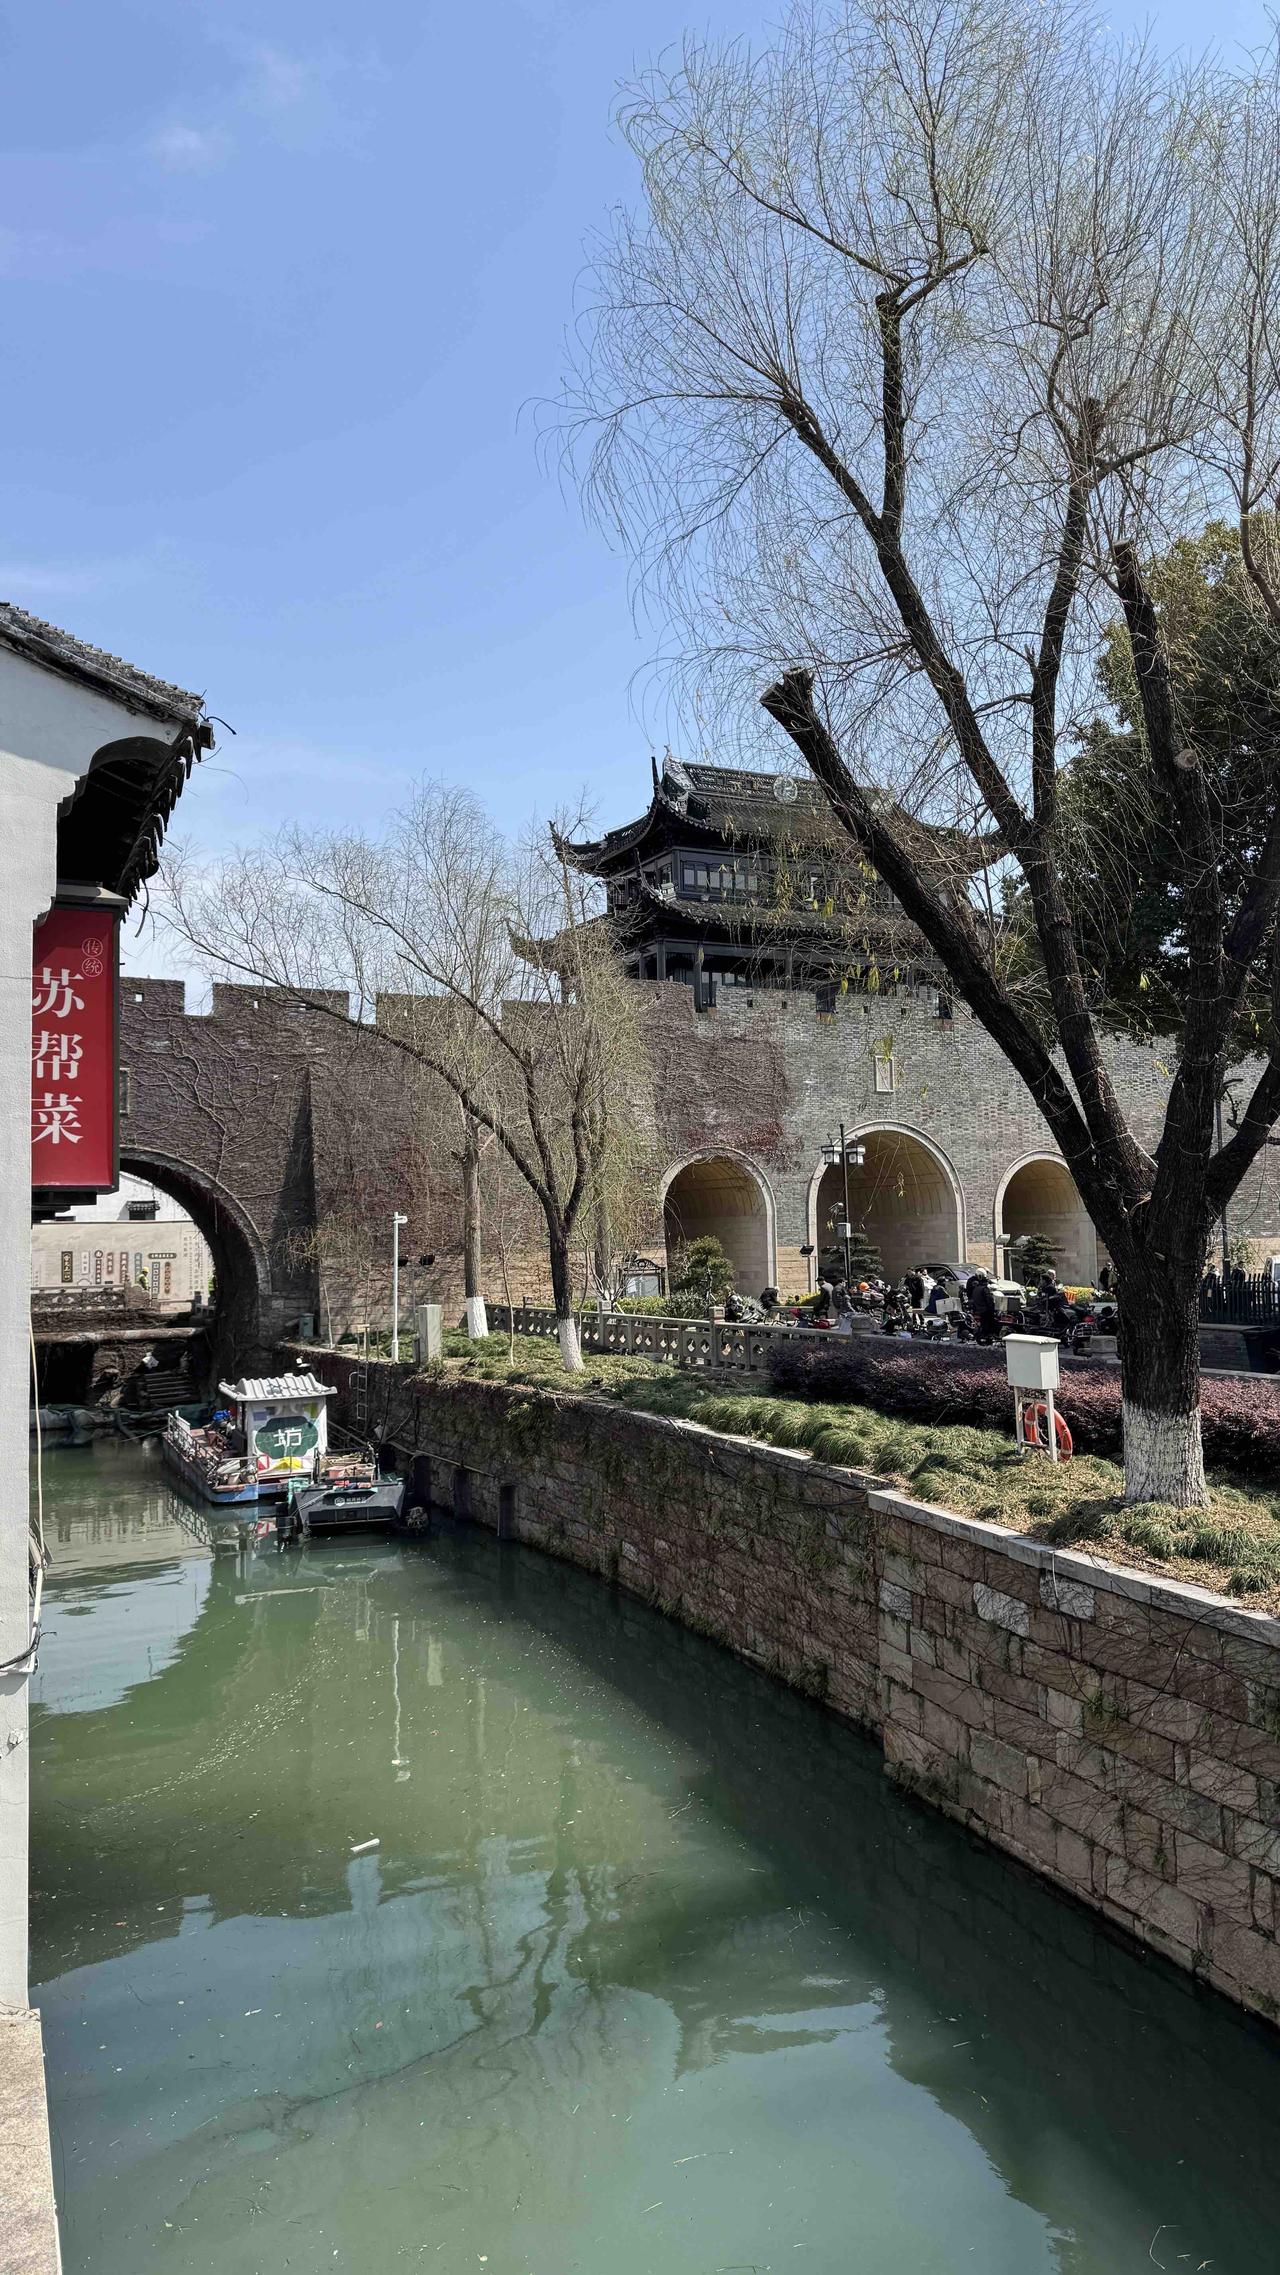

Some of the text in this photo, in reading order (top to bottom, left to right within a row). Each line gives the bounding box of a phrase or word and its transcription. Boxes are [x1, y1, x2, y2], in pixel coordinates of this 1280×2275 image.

[83, 939, 103, 976] 传统
[32, 968, 85, 1144] 苏帮菜
